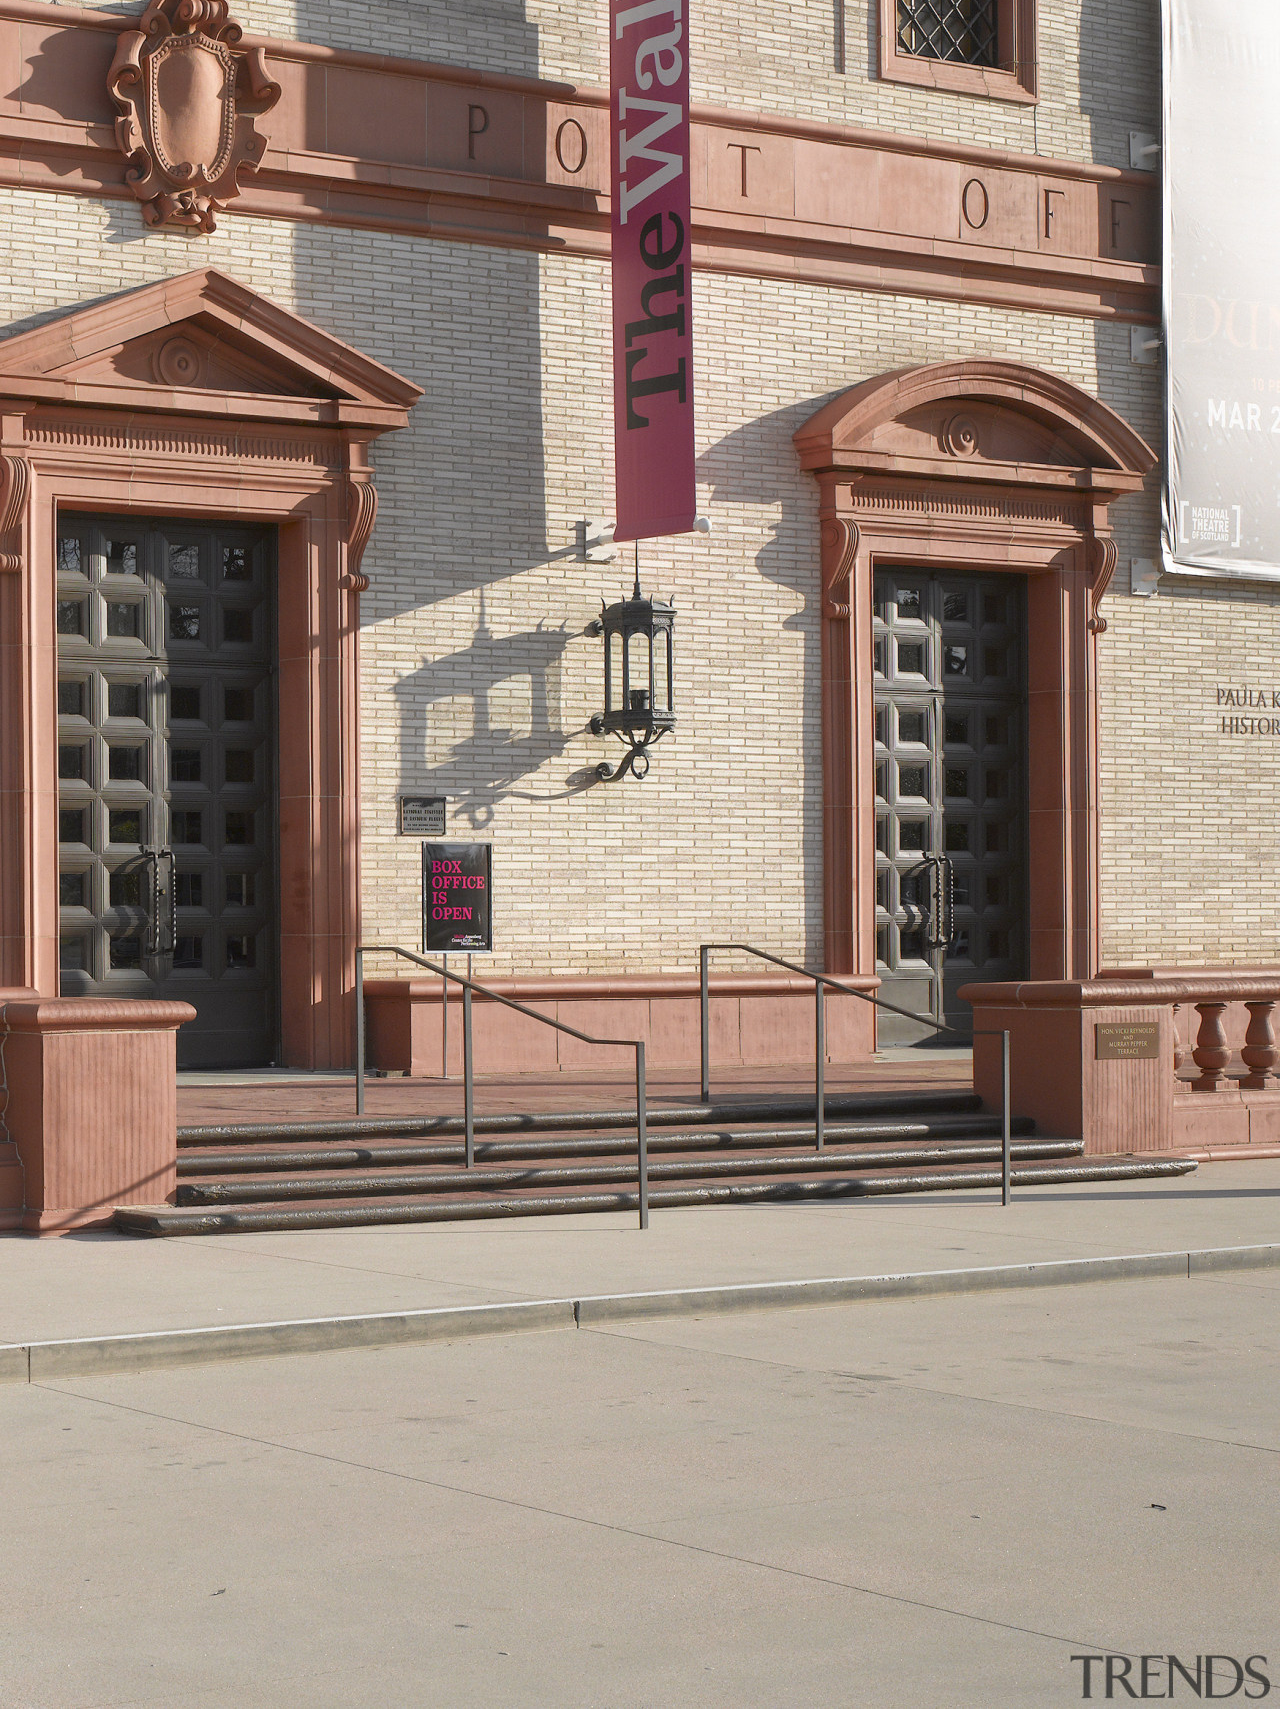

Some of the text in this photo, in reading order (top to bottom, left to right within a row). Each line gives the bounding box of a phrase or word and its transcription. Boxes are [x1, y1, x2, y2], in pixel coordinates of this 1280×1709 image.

[466, 102, 763, 199] POT
[1207, 397, 1262, 432] MAR
[1191, 506, 1230, 521] NATIONAL
[1191, 518, 1230, 533] THEATRE
[1191, 531, 1229, 542] OF SCOTLAND
[1217, 688, 1267, 708] PAULA
[431, 860, 462, 874] BOX
[431, 875, 485, 890] OFFICE
[432, 891, 448, 905] IS
[432, 906, 473, 920] OPEN
